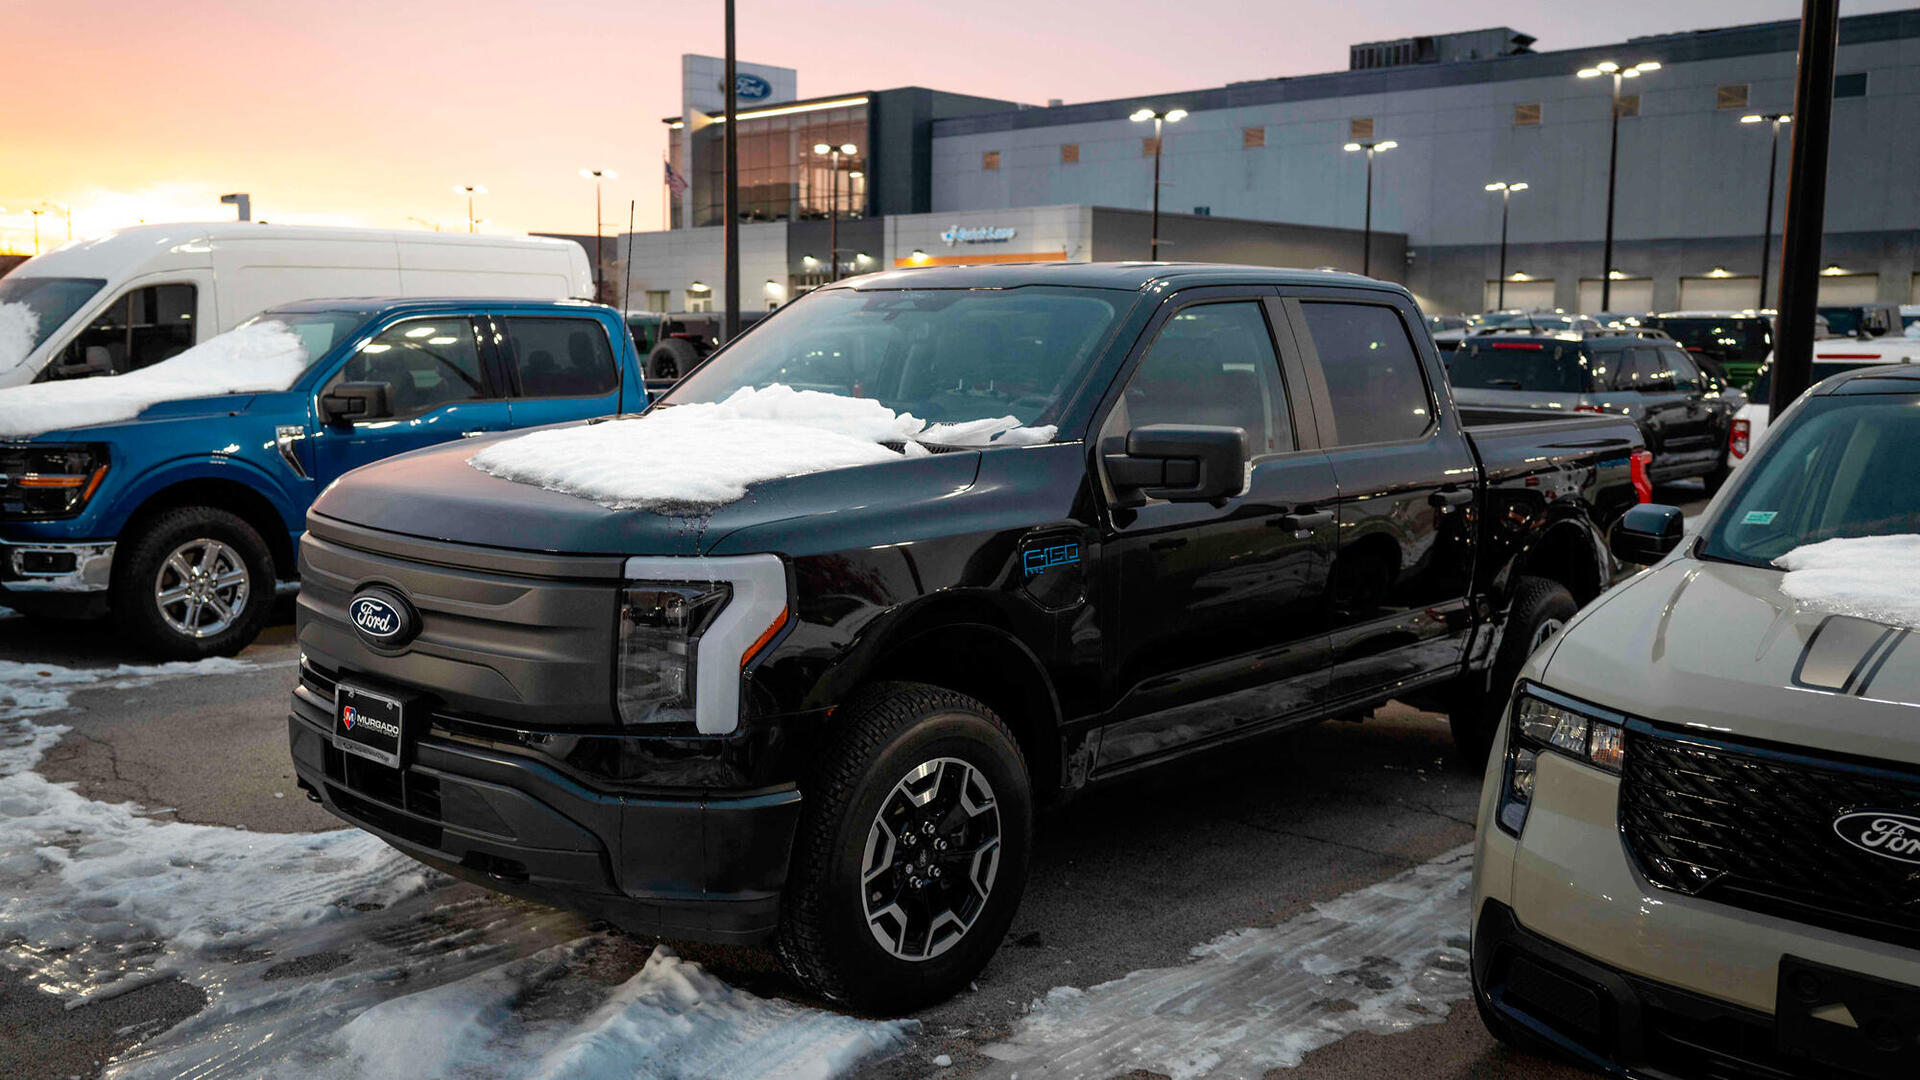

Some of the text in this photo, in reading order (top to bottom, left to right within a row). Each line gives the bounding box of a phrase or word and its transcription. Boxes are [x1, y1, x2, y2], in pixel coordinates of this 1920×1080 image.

[357, 601, 391, 632] Ford
[356, 713, 400, 735] MURGADO
[1860, 818, 1920, 855] For
